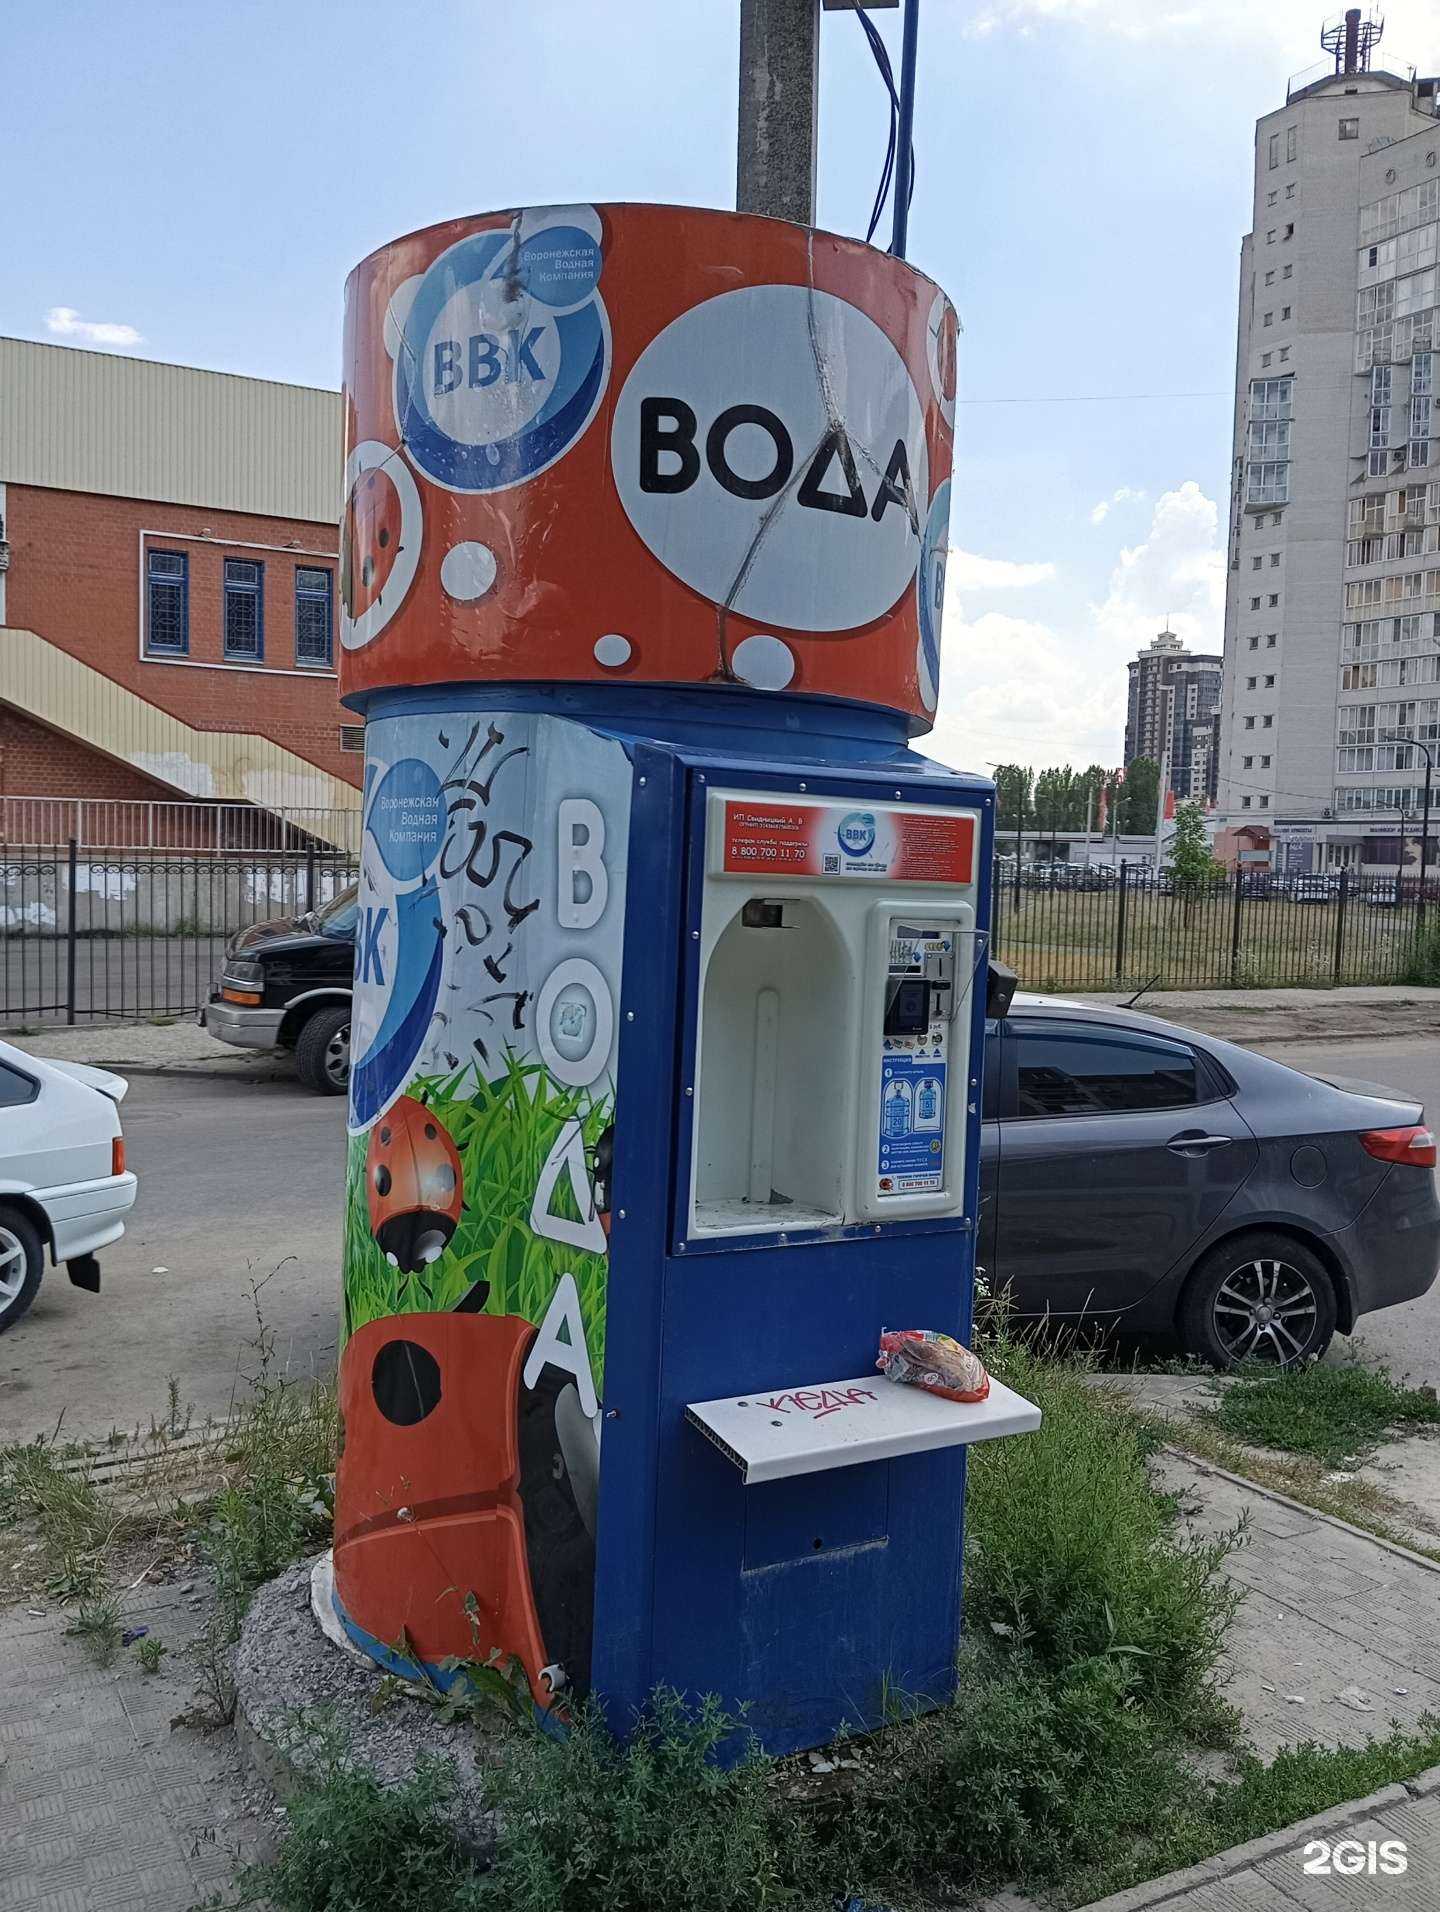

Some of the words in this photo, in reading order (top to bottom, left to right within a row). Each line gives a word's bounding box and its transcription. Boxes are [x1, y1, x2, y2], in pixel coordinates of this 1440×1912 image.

[523, 248, 595, 262] Воронежская
[554, 260, 595, 270] Водная
[539, 271, 594, 282] Компания
[434, 326, 547, 399] ВВК
[639, 396, 921, 537] ВОДА
[381, 796, 440, 813] Воронежская
[401, 812, 438, 826] Водная
[388, 830, 437, 844] Компания
[846, 828, 867, 841] ВВК
[731, 846, 738, 856] 8
[740, 847, 758, 857] 800
[760, 848, 777, 858] 700
[780, 849, 791, 858] 11
[794, 850, 807, 859] 70
